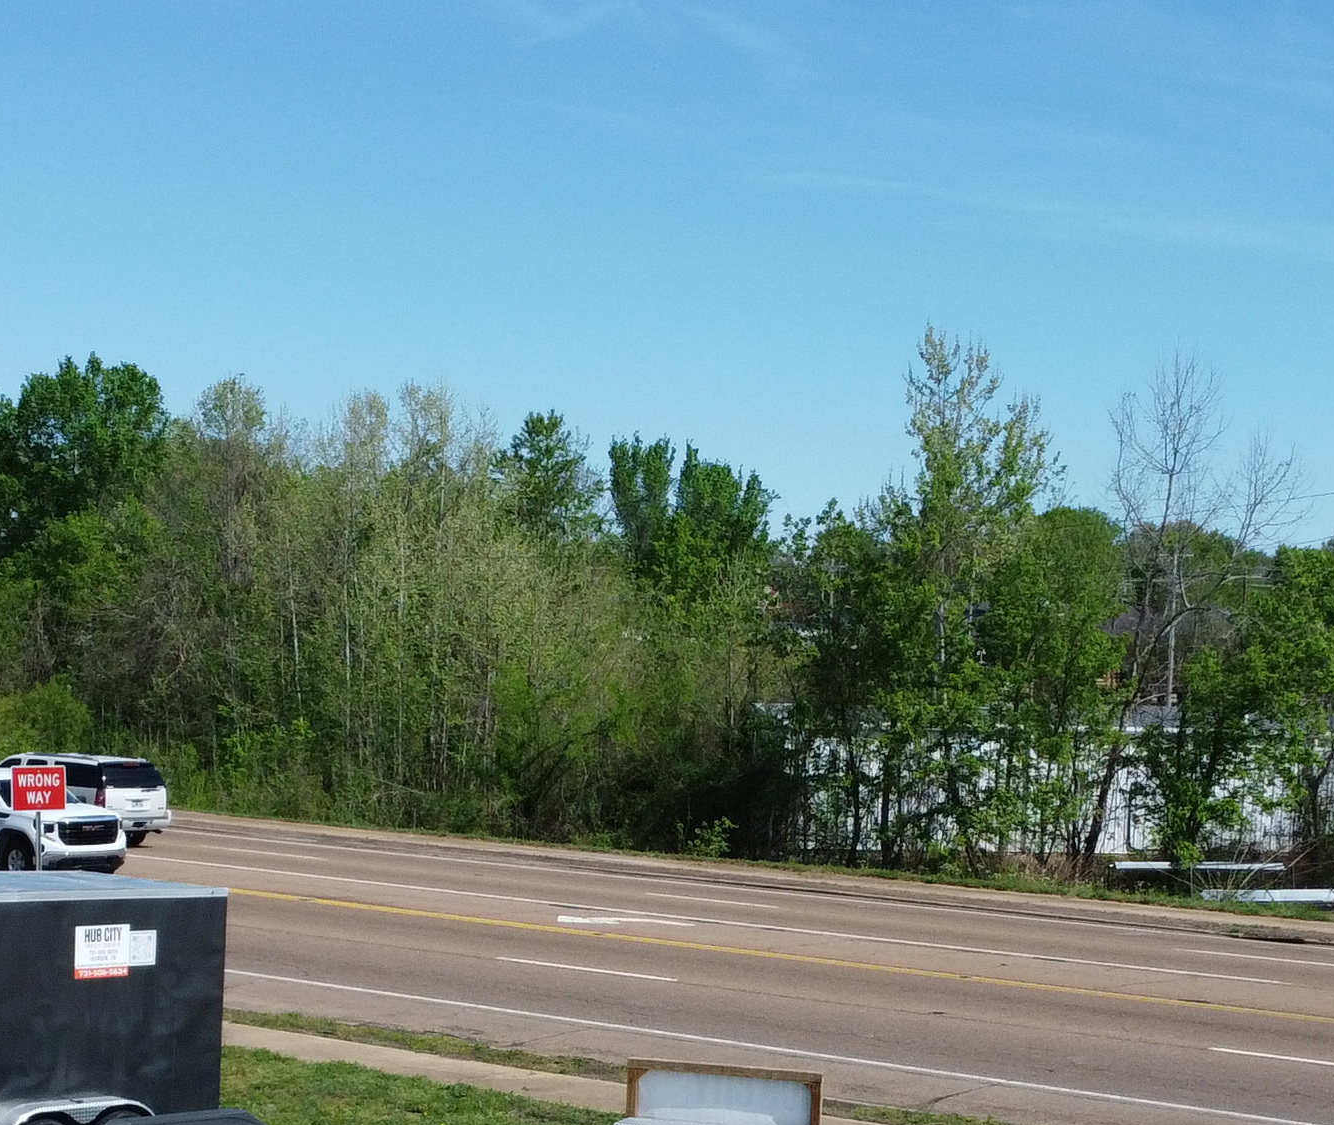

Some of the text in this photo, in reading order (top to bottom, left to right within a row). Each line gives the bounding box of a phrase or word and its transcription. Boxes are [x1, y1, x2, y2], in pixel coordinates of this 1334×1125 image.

[17, 773, 60, 788] WRONG
[26, 791, 52, 804] WAY
[84, 926, 123, 943] HUB CITY
